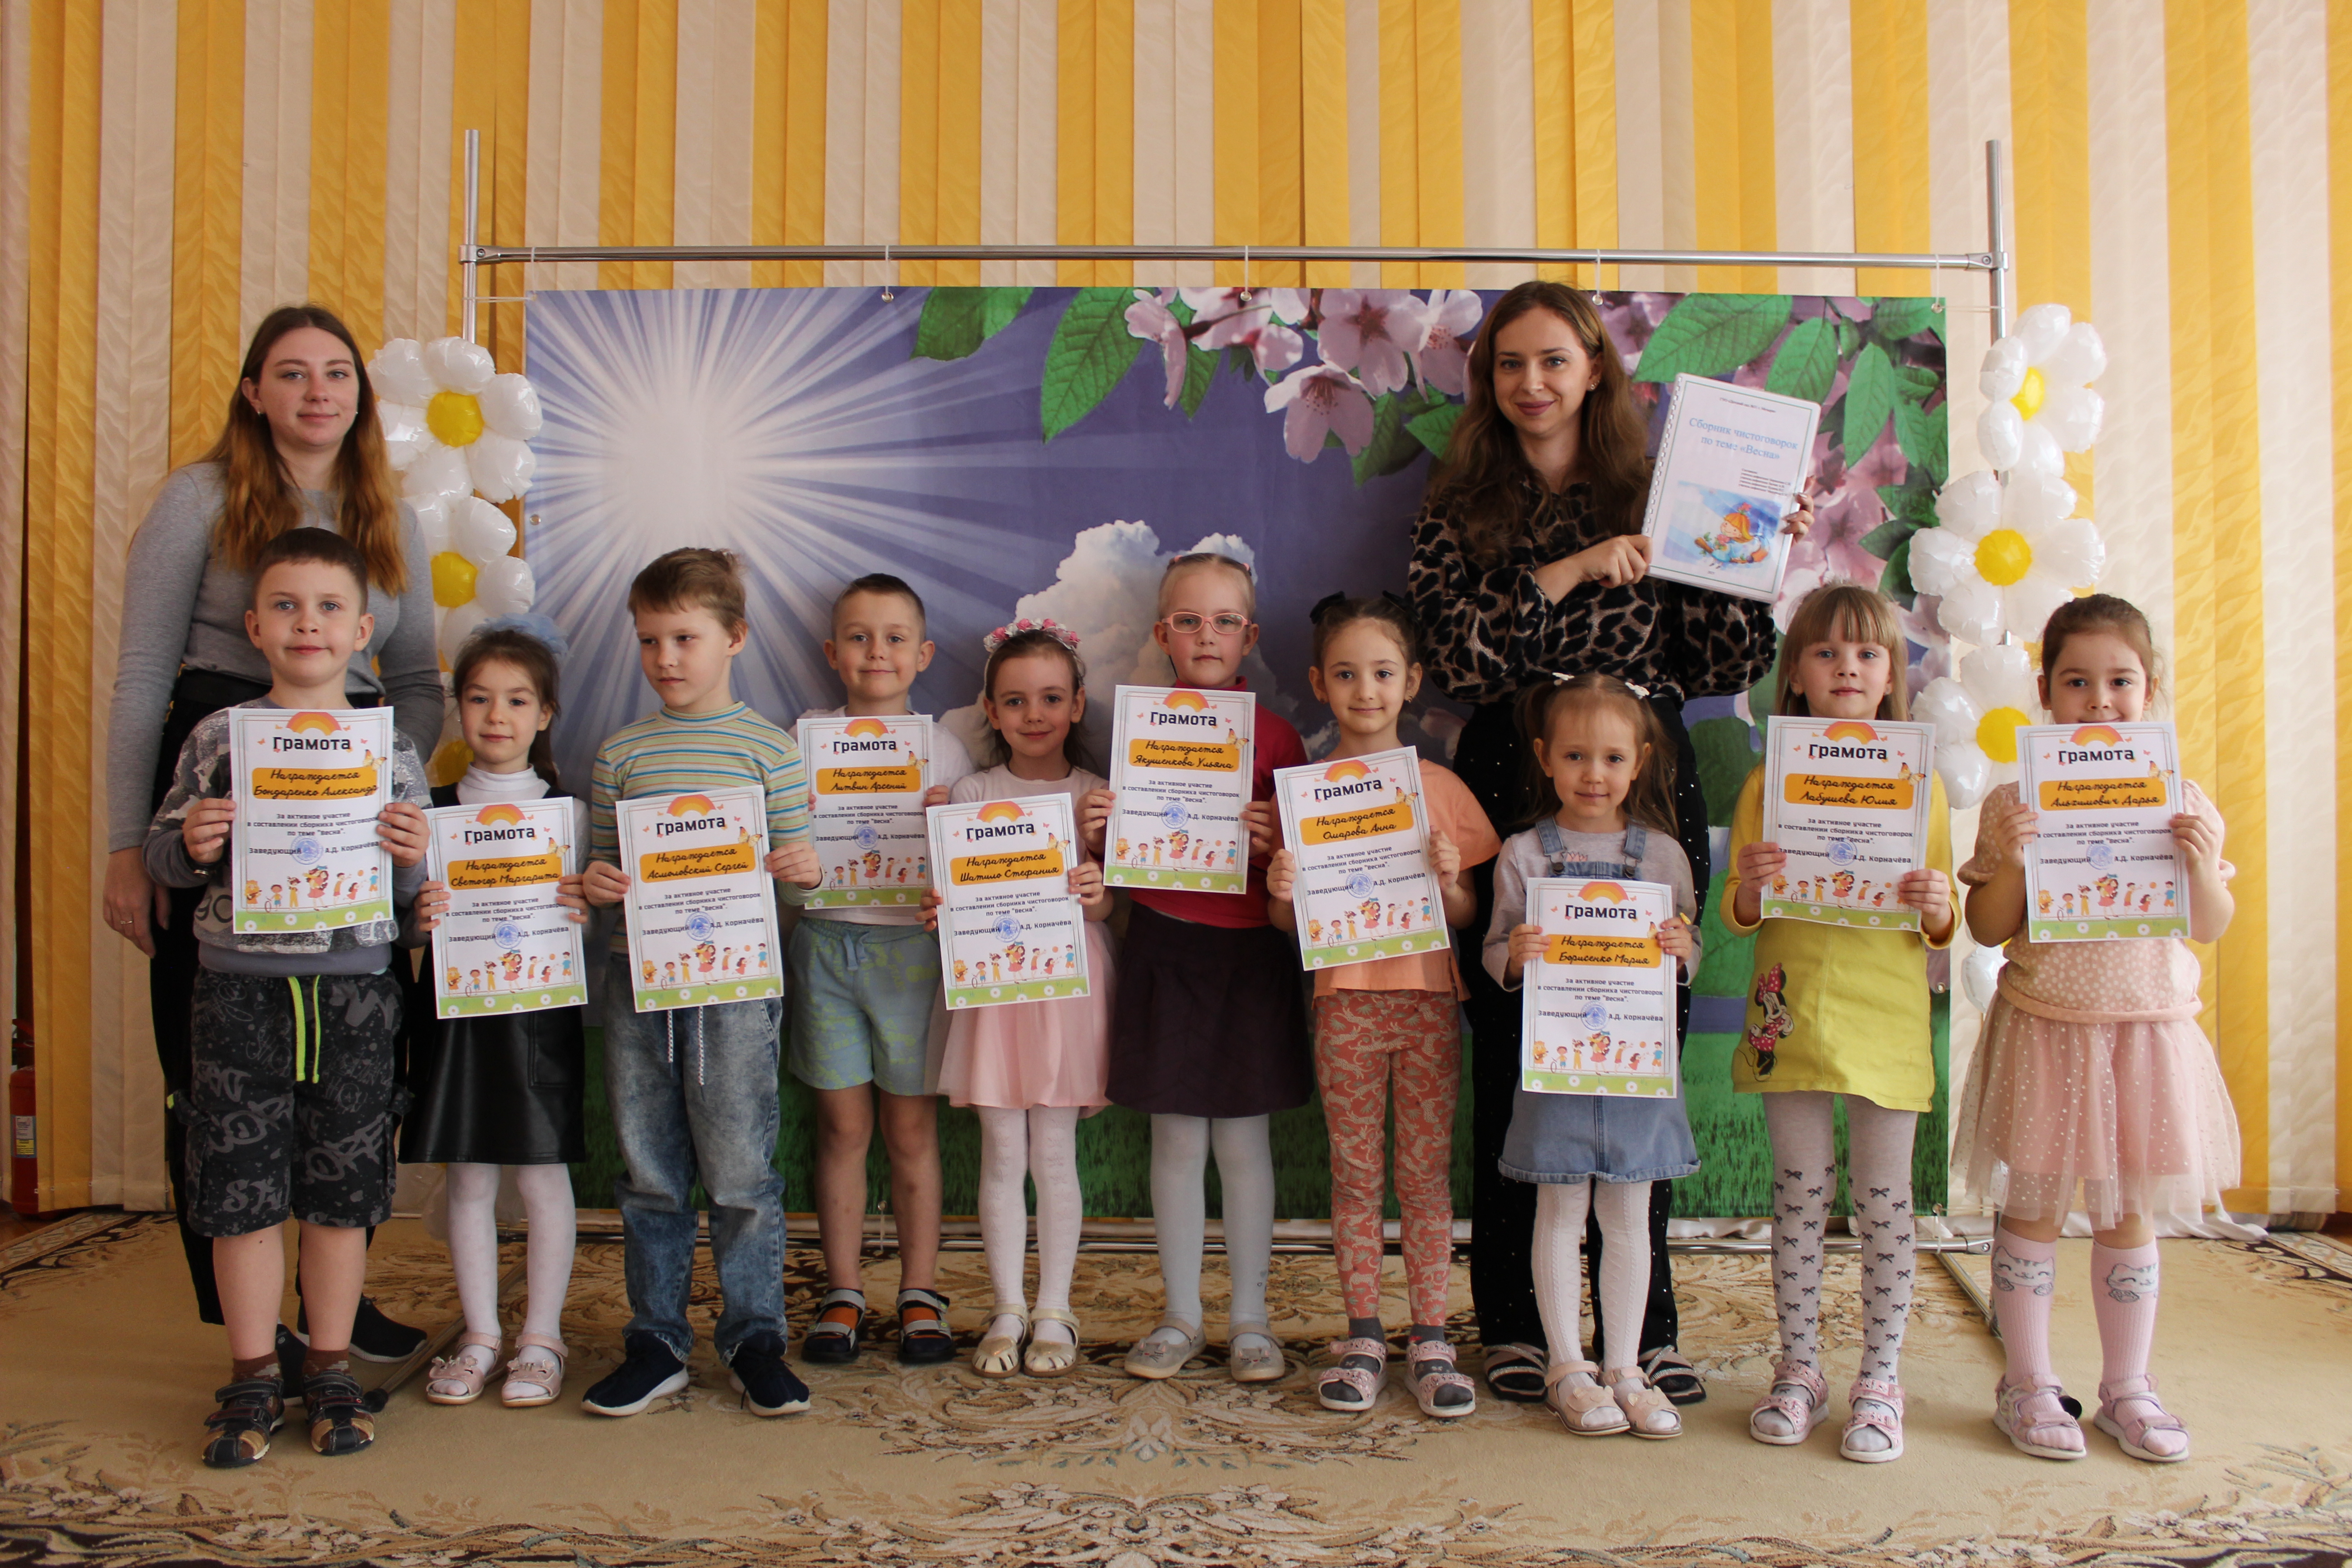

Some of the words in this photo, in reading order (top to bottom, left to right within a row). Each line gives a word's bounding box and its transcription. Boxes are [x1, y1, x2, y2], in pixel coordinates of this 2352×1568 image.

[1689, 417, 1731, 435] Сборник
[1734, 429, 1798, 450] чистоговорок
[1701, 436, 1712, 445] по
[1715, 440, 1737, 450] теме
[1740, 444, 1780, 459] «Весна»
[1151, 712, 1217, 726] Грамота
[273, 737, 351, 751] Грамота
[833, 741, 897, 753] Грамота
[1145, 741, 1224, 755] Награждается
[1809, 744, 1887, 760] Грамота
[2058, 750, 2135, 764] Грамота
[1133, 755, 1195, 767] Якушенкова
[1196, 758, 1234, 769] Ульяна
[270, 769, 361, 784] Награждается
[833, 769, 907, 779] Награждается
[830, 782, 868, 791] Литвин
[871, 782, 907, 792] Арсений
[1314, 779, 1382, 800] Грамота
[1804, 775, 1896, 792] Награждается
[2057, 781, 2146, 793] Награждается
[254, 786, 318, 799] Бондаренко
[321, 785, 378, 796] Александр
[1800, 791, 1857, 805] Лабушева
[1860, 796, 1897, 805] Юлия
[2122, 796, 2160, 807] Дарья
[1317, 808, 1396, 827] Награждается
[656, 817, 725, 836] Грамота
[966, 823, 1034, 840] Грамота
[1323, 826, 1368, 839] Омарова
[1370, 824, 1396, 833] Анна
[464, 828, 535, 844] Грамота
[657, 849, 737, 864] Награждается
[1367, 846, 1392, 855] участие
[466, 858, 547, 872] Награждается
[966, 853, 1046, 868] Награждается
[1308, 861, 1347, 871] составлении
[1349, 857, 1377, 865] сборника
[1380, 849, 1421, 860] чистоговорок
[647, 866, 712, 879] Асмоловский
[715, 862, 749, 874] Сергей
[960, 873, 1002, 882] Шатило
[1004, 867, 1059, 878] Стефания
[451, 877, 497, 887] Светогор
[500, 873, 560, 886] Маргарита
[1307, 884, 1353, 896] Заведующий
[644, 901, 684, 910] составлении
[717, 892, 761, 902] чистоговорок
[1565, 905, 1637, 919] Грамота
[642, 926, 689, 935] Заведующий
[954, 926, 1000, 936] Заведующий
[449, 934, 496, 942] Заведующий
[1561, 936, 1645, 951] Награждается
[1559, 952, 1612, 964] Борисенко
[1615, 955, 1650, 966] Мария
[1539, 1010, 1587, 1019] Заведующий
